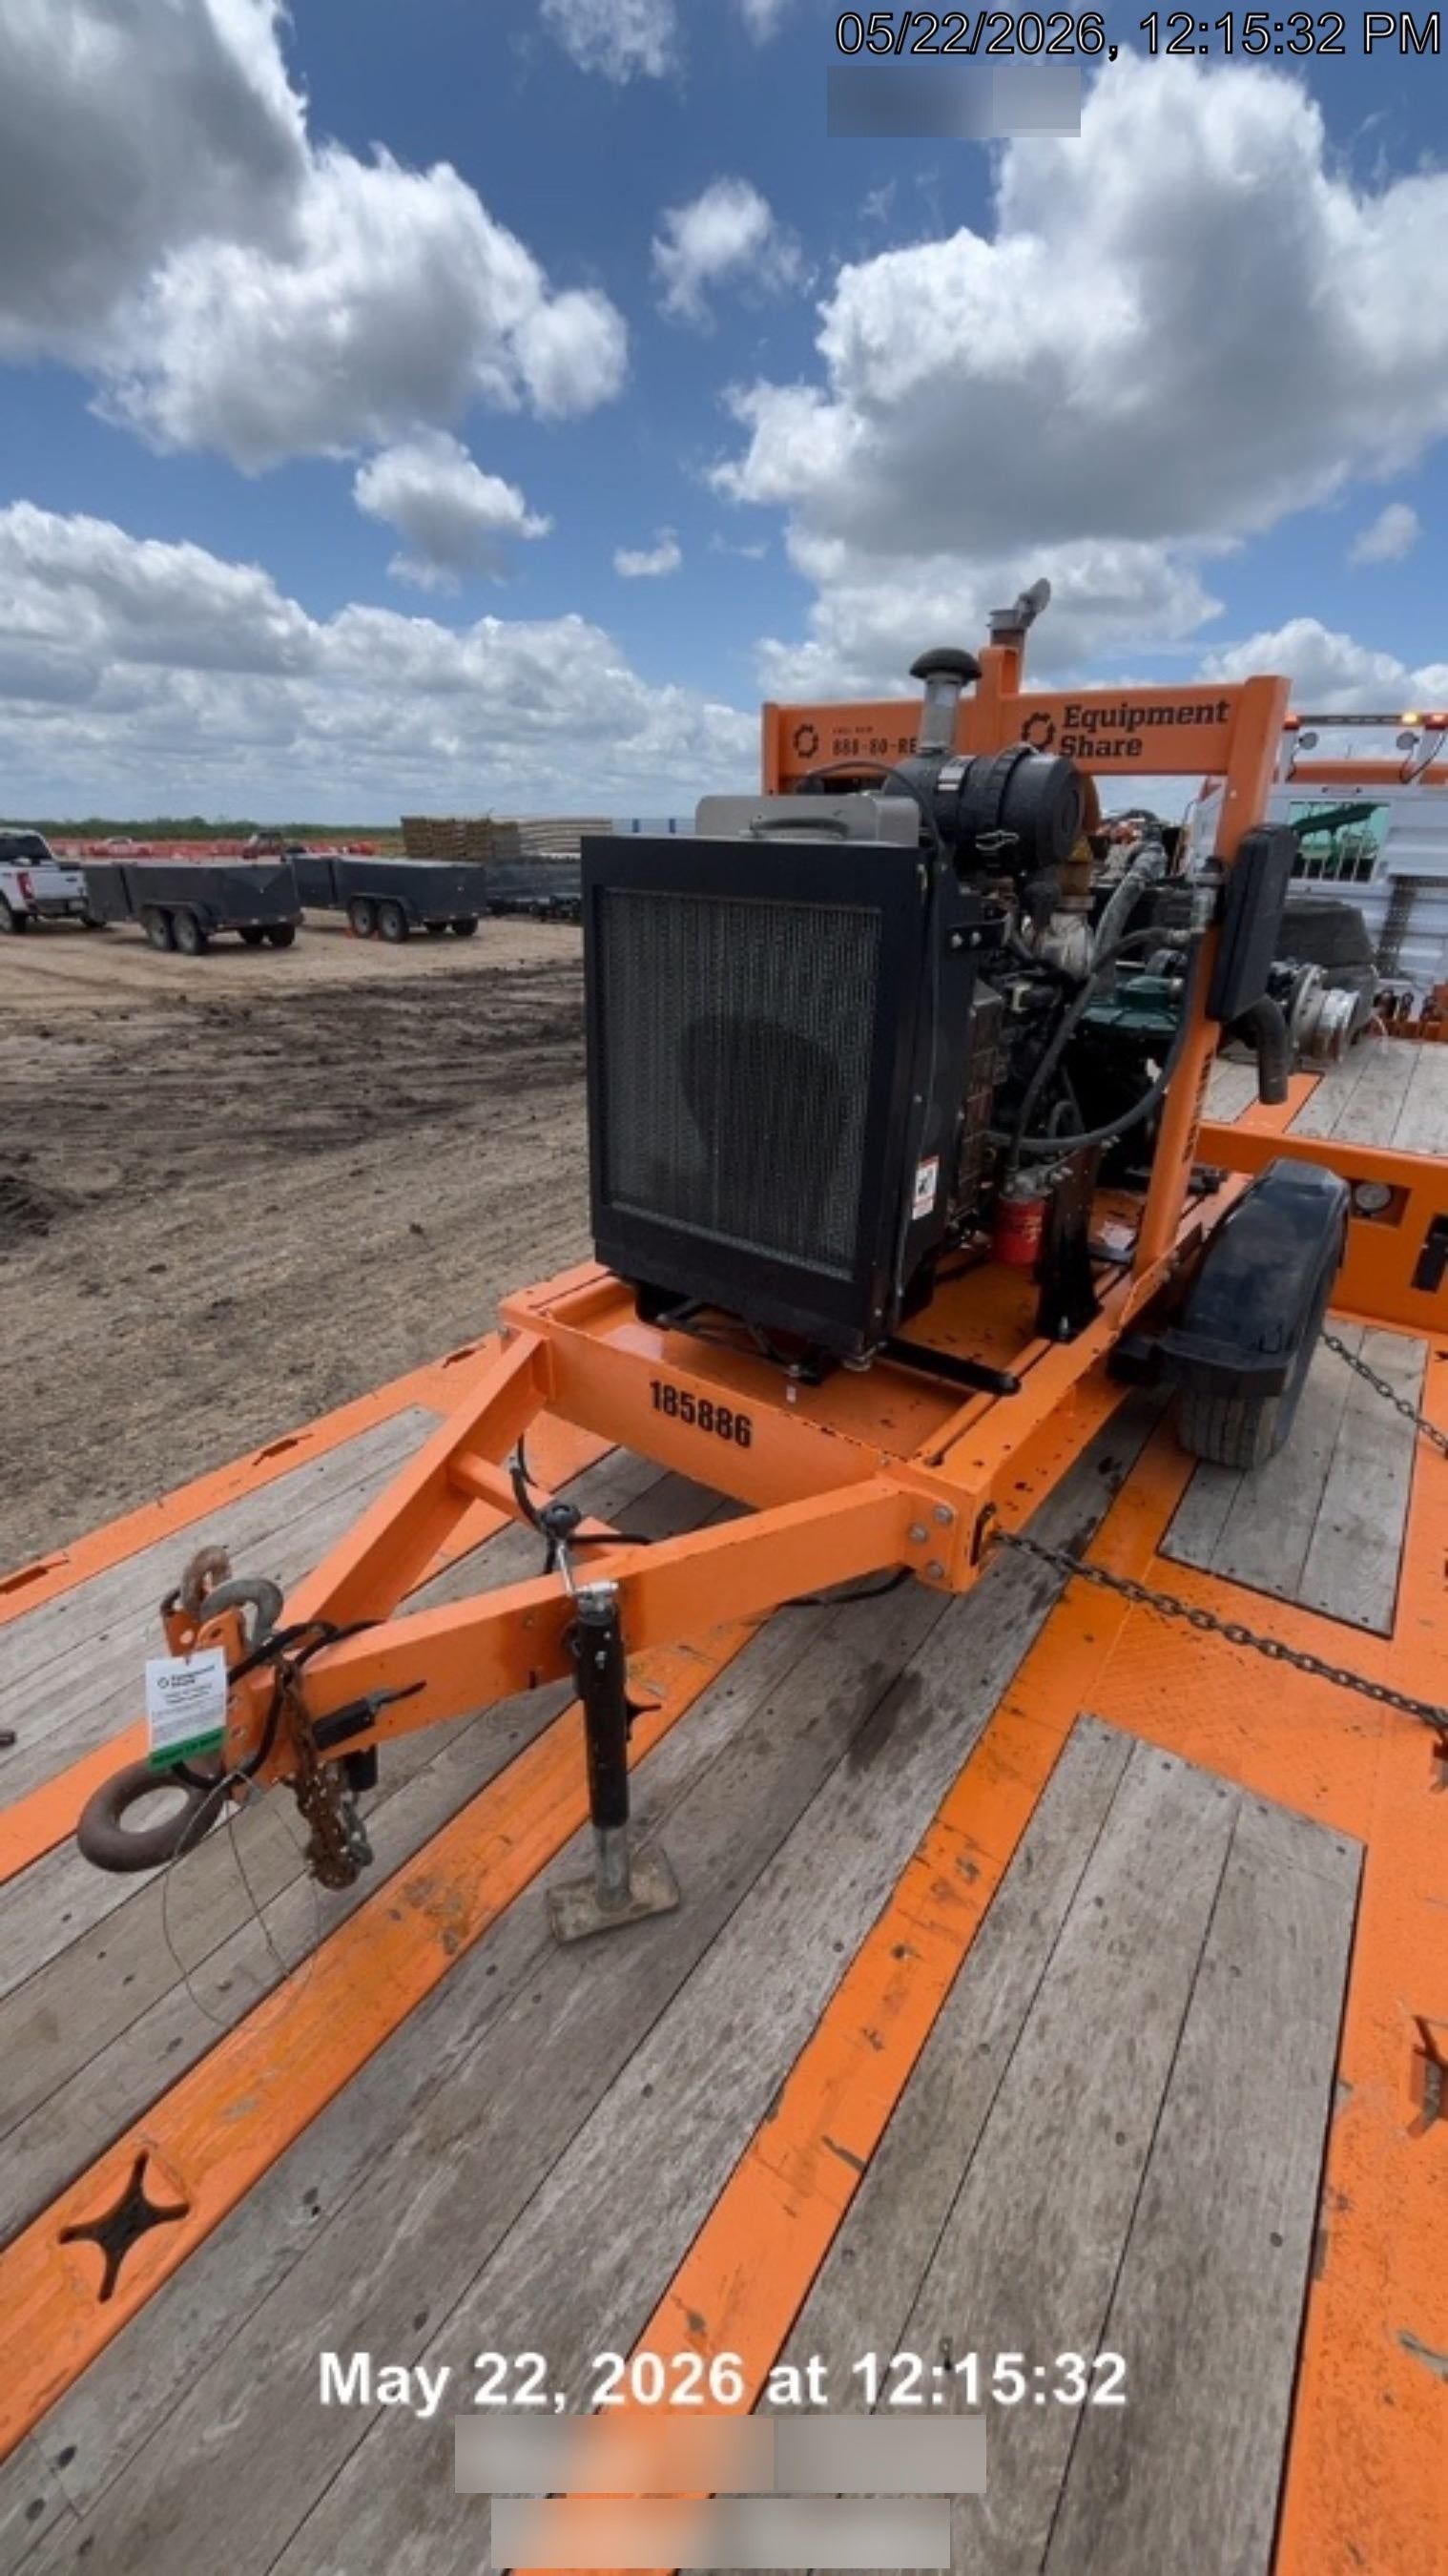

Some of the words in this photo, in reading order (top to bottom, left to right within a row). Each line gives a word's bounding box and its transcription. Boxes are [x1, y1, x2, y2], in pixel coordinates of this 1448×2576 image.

[1062, 699, 1231, 733] Equipment
[832, 737, 918, 756] 888-80-RE
[1059, 735, 1143, 758] Share
[650, 1379, 753, 1448] 185886
